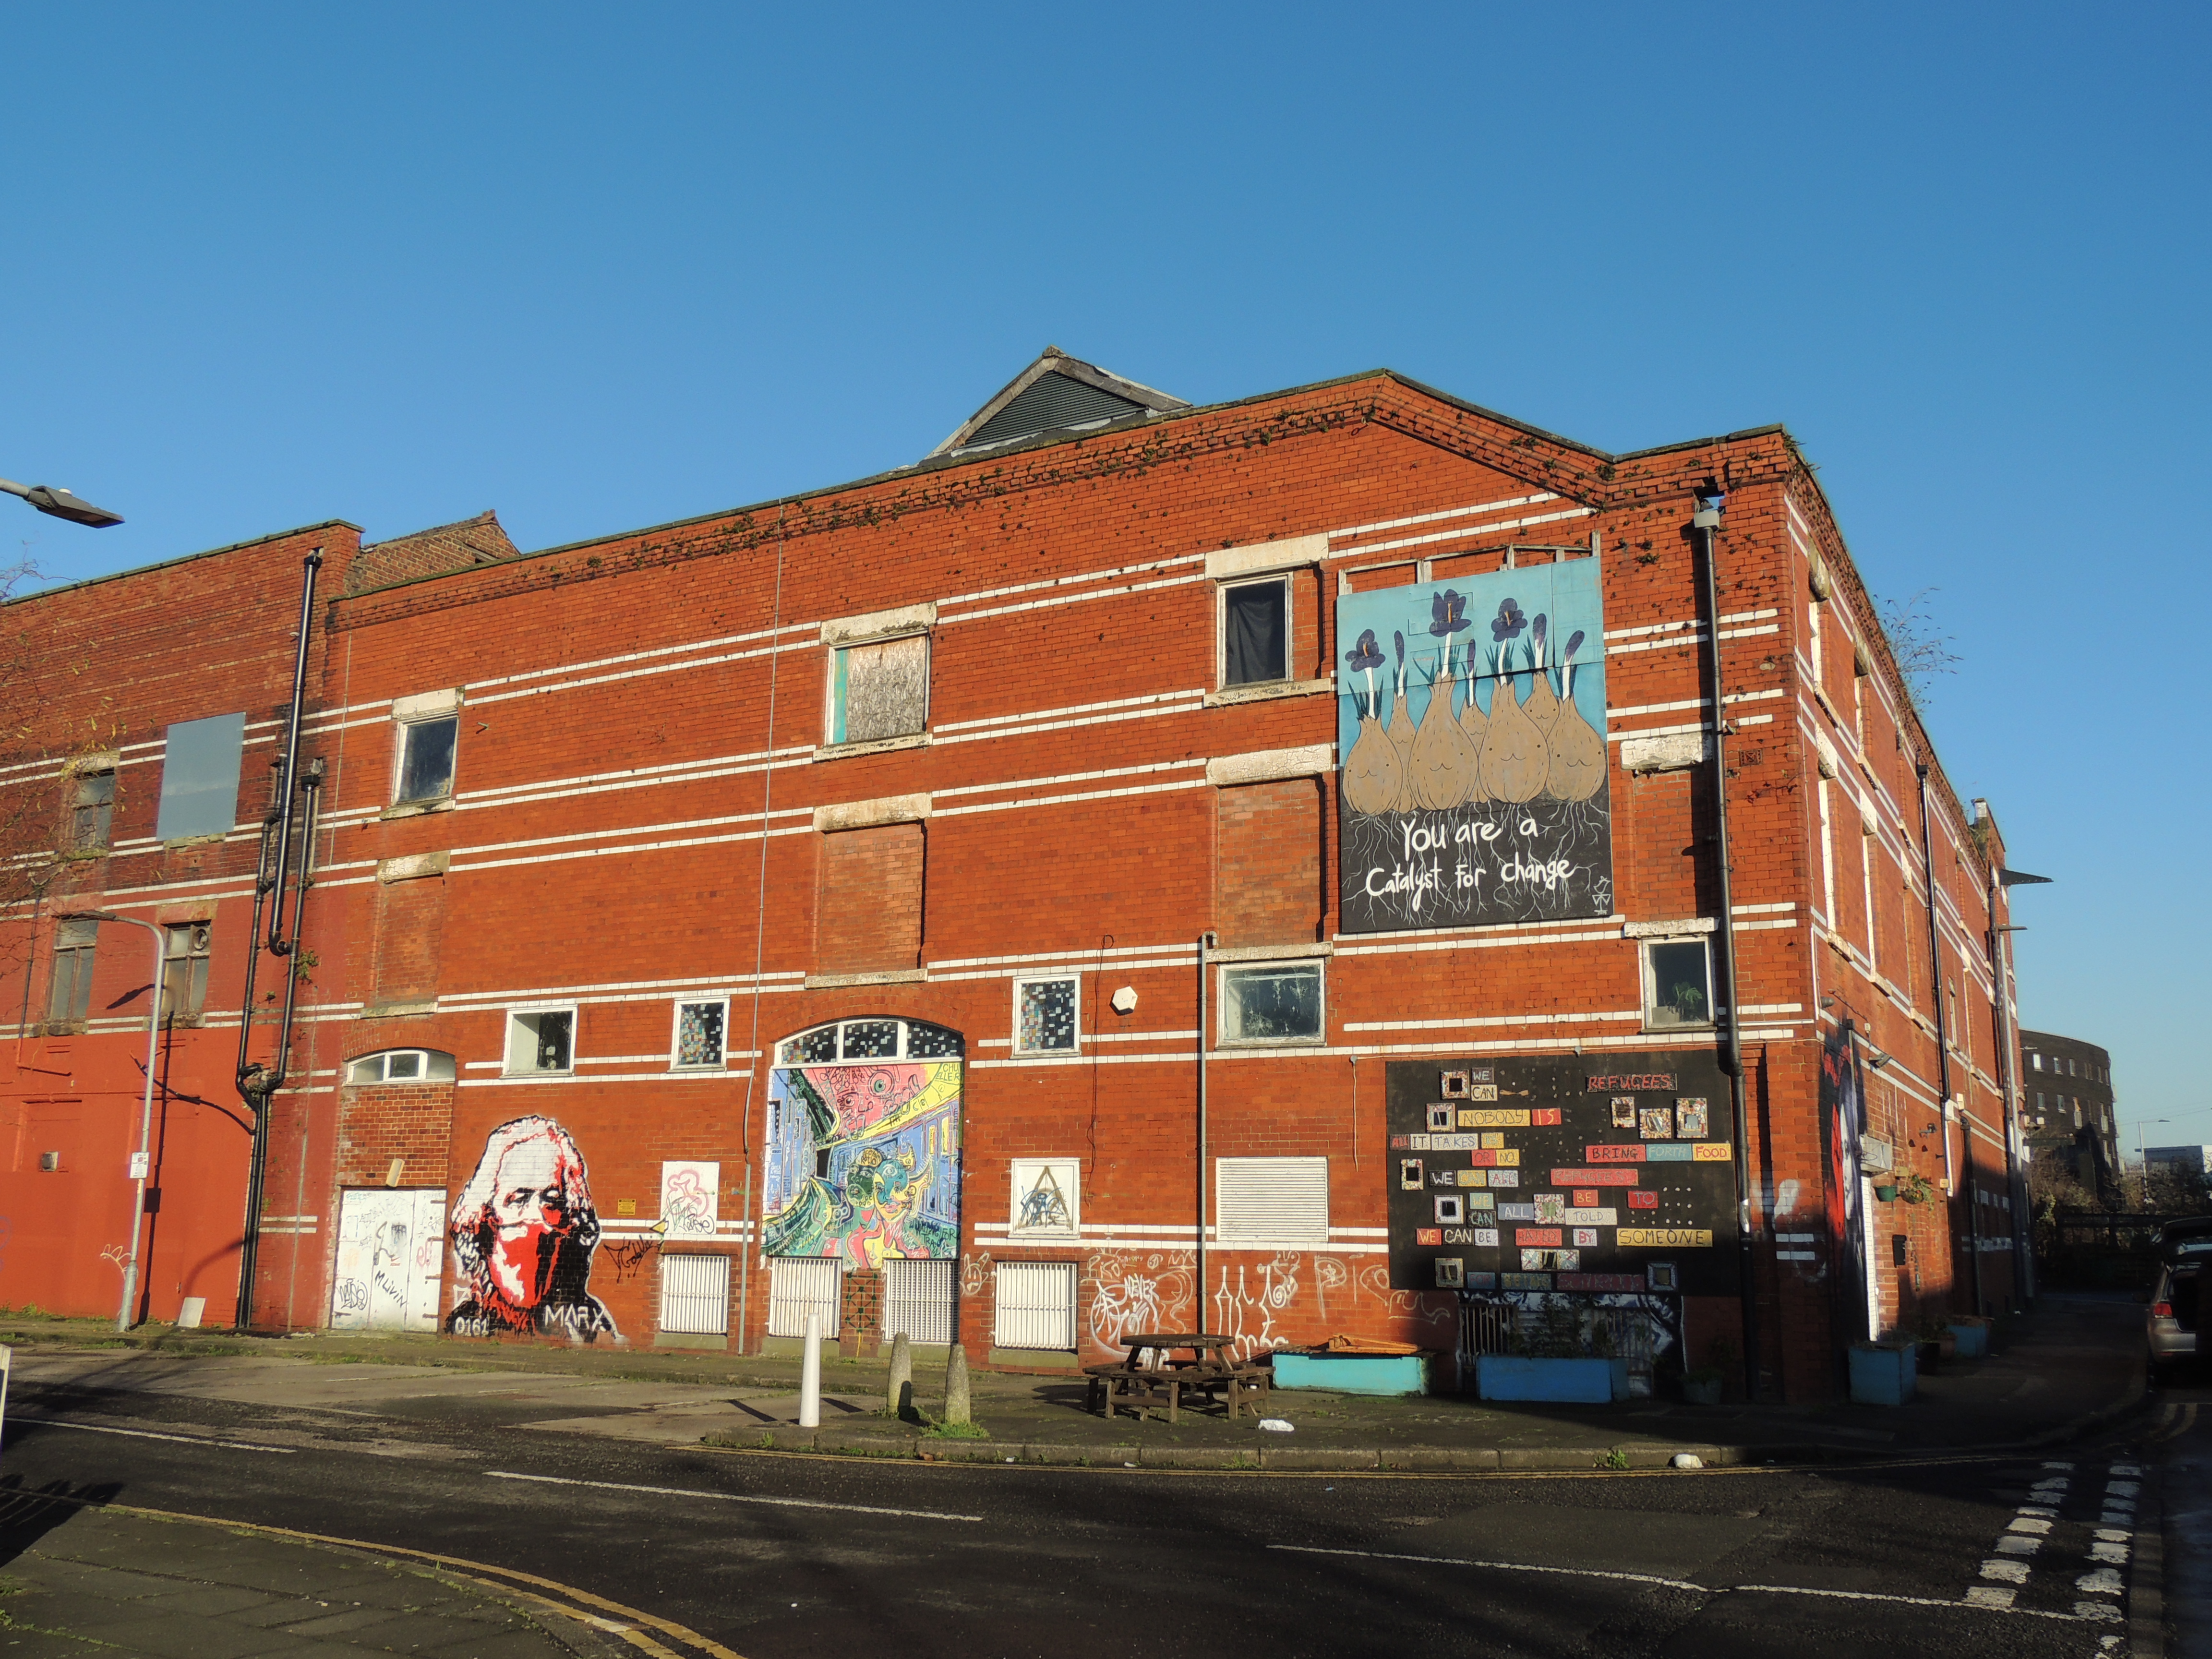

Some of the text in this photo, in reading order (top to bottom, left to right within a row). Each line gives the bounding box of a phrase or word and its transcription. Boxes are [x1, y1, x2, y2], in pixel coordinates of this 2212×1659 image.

[1401, 818, 1538, 861] You are a
[1366, 856, 1442, 912] Catalyst
[1501, 852, 1575, 890] change
[1473, 1070, 1490, 1080] WE
[1588, 1074, 1671, 1089] REFUGEES
[1472, 1087, 1494, 1099] CAN
[1464, 1110, 1554, 1125] NOBODY IS
[1412, 1136, 1426, 1148] IT
[1436, 1136, 1475, 1148] TAKES
[1475, 1153, 1490, 1162] OR
[1593, 1146, 1727, 1159] BRING FORTH FOOD
[1432, 1172, 1516, 1185] WE CAN ALL
[1554, 1171, 1625, 1182] REFUGEES
[1473, 1196, 1490, 1207] WE
[1577, 1192, 1592, 1203] BE
[1634, 1192, 1655, 1205] TO
[1470, 1212, 1493, 1225] CAN
[1504, 1206, 1529, 1218] ALL
[1574, 1211, 1604, 1222] TOLD
[1419, 1230, 1436, 1243] WE
[1444, 1229, 1472, 1243] CAN
[1479, 1232, 1491, 1242] BE
[1579, 1232, 1594, 1244] BY
[1619, 1229, 1704, 1245] SOMEONE
[1470, 1274, 1491, 1285] FOR
[544, 1303, 606, 1332] MARX
[455, 1316, 489, 1337] 0161
